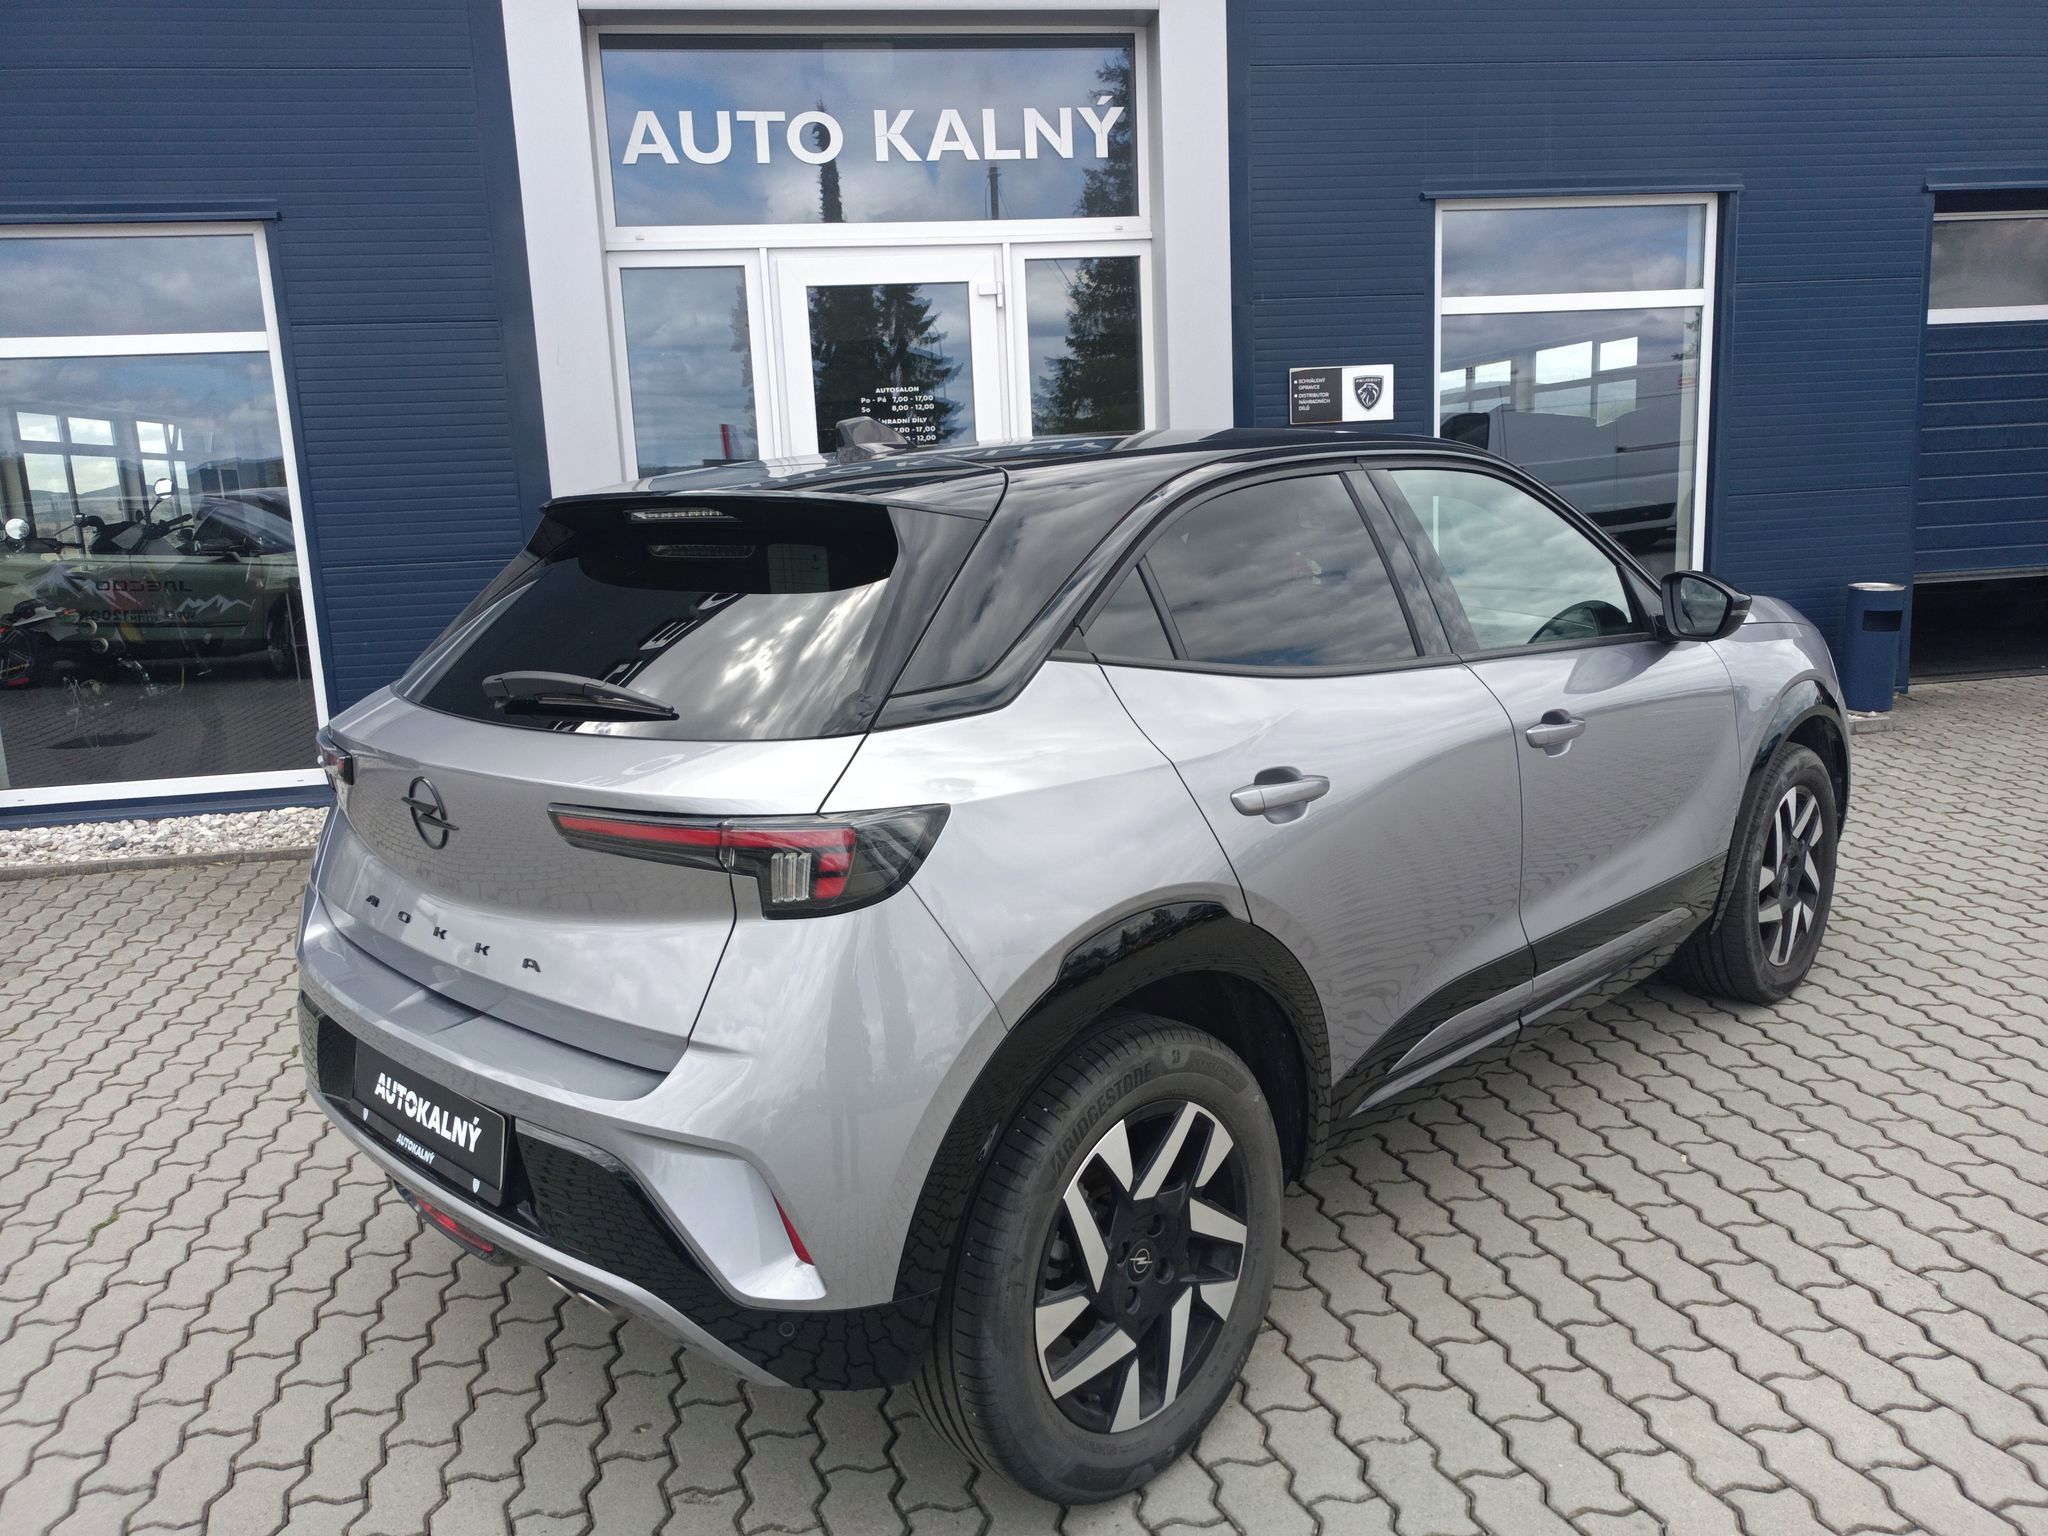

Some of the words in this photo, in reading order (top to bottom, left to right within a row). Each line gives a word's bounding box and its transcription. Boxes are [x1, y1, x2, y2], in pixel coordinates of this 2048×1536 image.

[622, 109, 844, 165] AUTO
[873, 95, 1126, 163] KALNÝ
[875, 386, 920, 394] AUTOSALON
[878, 417, 911, 425] HRADNÍ
[374, 1072, 483, 1153] AUTOKALNÝ
[395, 1133, 436, 1165] AUTOKALNÝ
